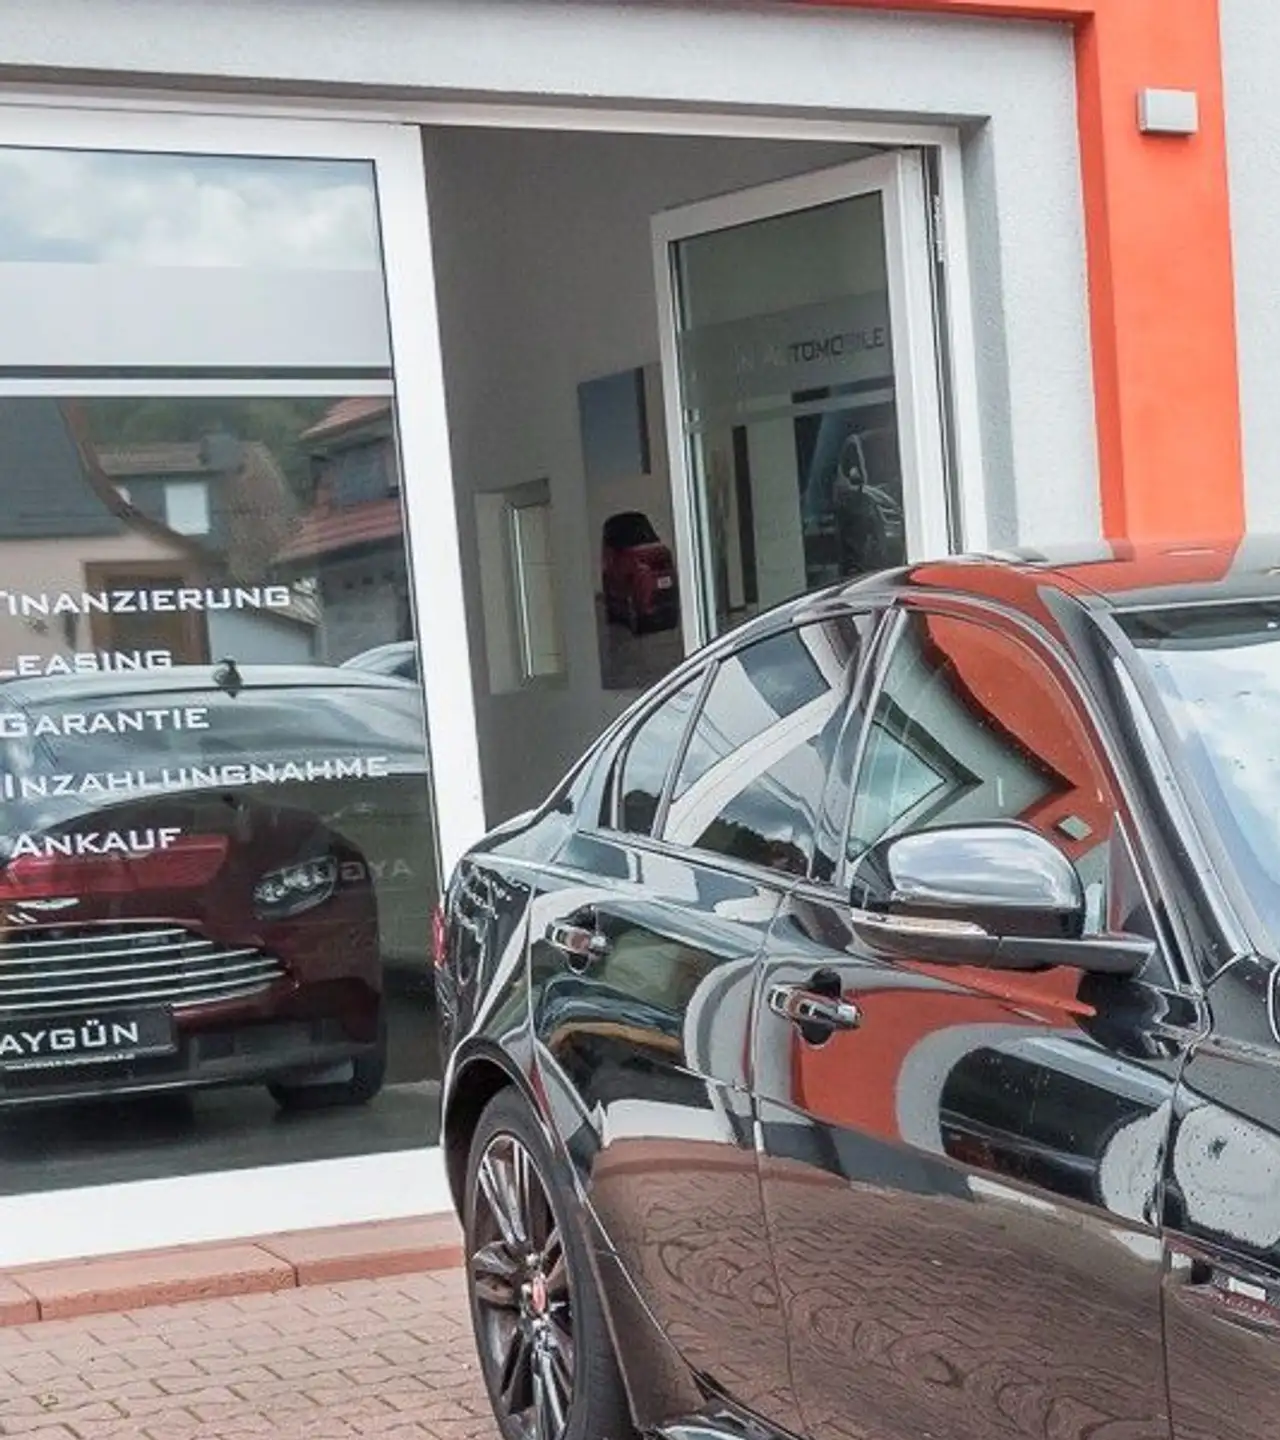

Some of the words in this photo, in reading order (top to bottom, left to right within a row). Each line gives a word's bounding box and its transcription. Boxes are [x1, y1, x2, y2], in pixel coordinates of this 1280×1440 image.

[0, 708, 210, 737] GARANTIE
[3, 757, 389, 799] INZAHLUNGNAHME
[10, 828, 182, 858] ANKAUF
[0, 1019, 139, 1055] AYGÜN
